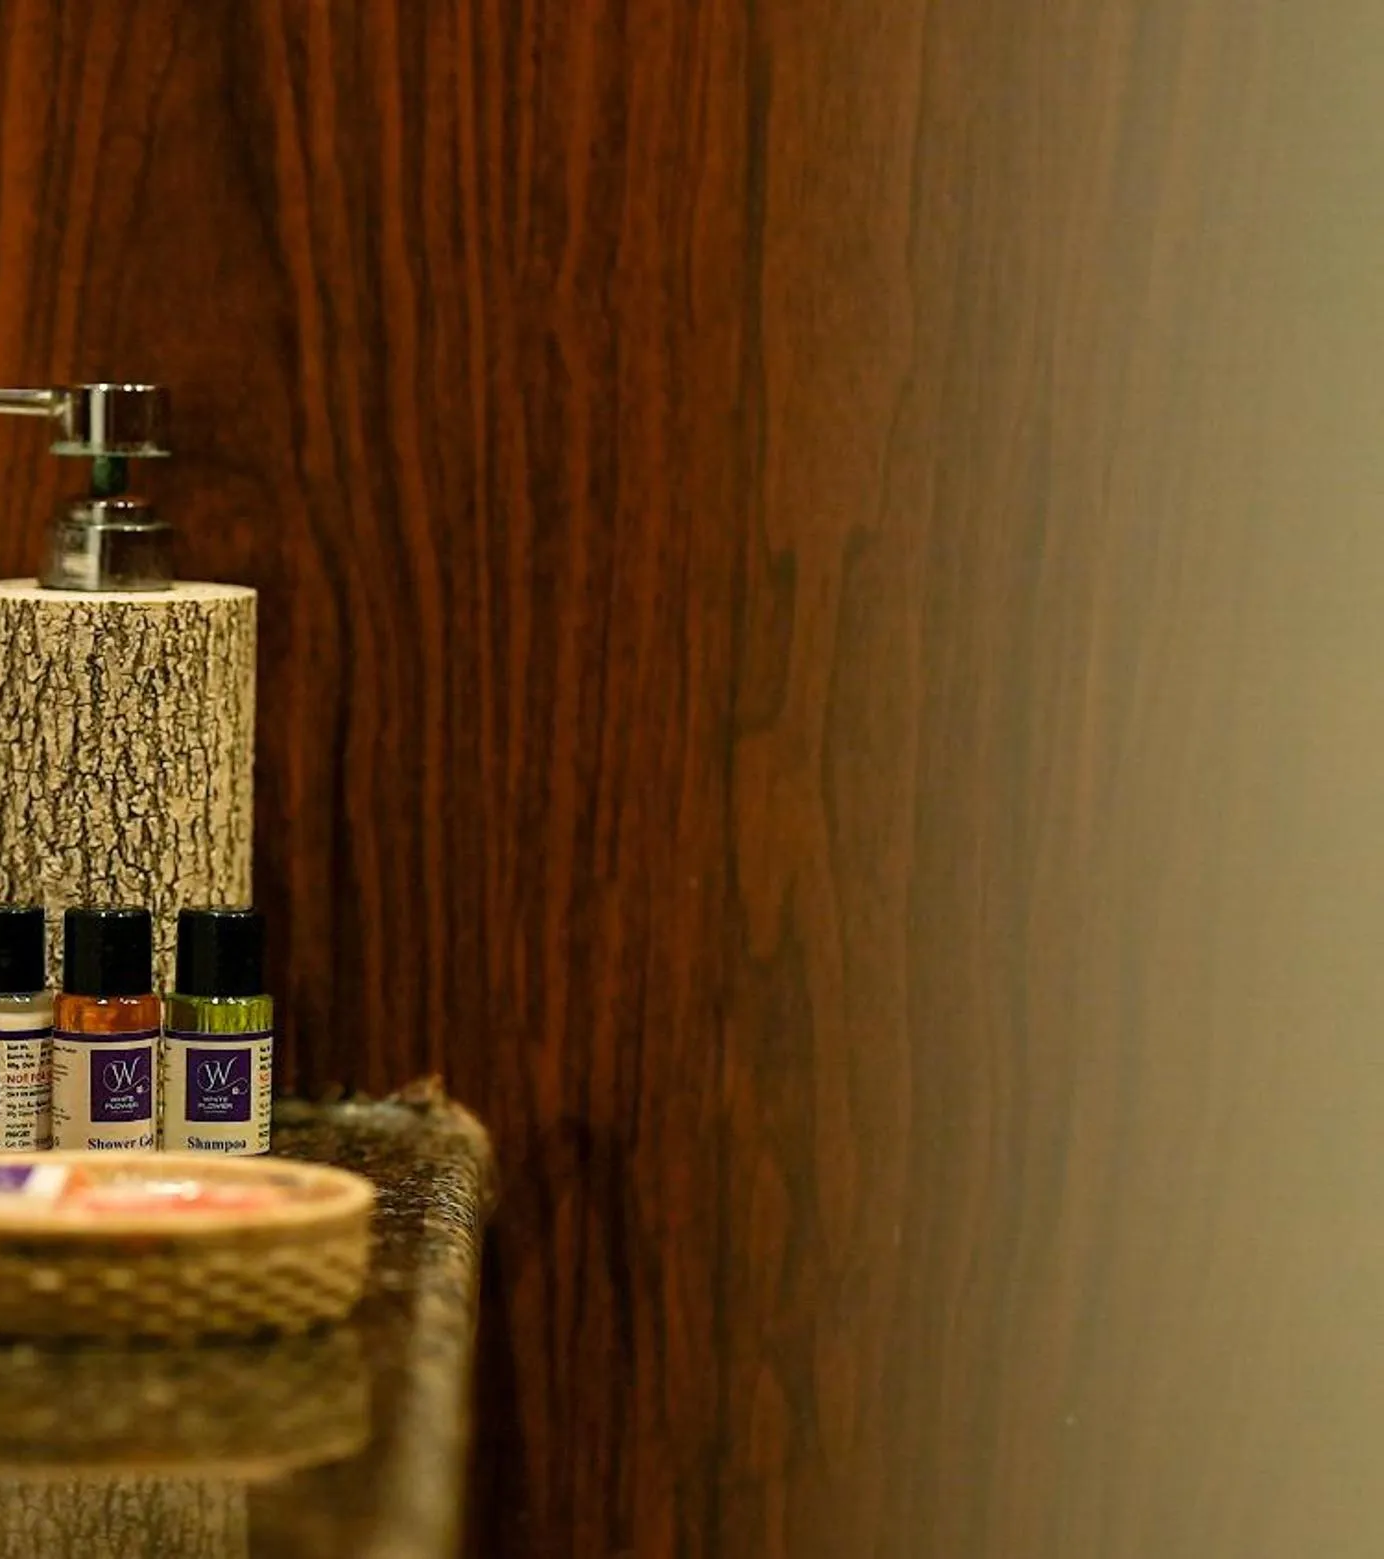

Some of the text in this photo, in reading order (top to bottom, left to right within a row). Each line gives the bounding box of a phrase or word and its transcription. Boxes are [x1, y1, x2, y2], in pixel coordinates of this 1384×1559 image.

[103, 1055, 142, 1093] W
[197, 1055, 238, 1093] W
[87, 1137, 137, 1151] Shower
[186, 1135, 247, 1153] Shampoo
